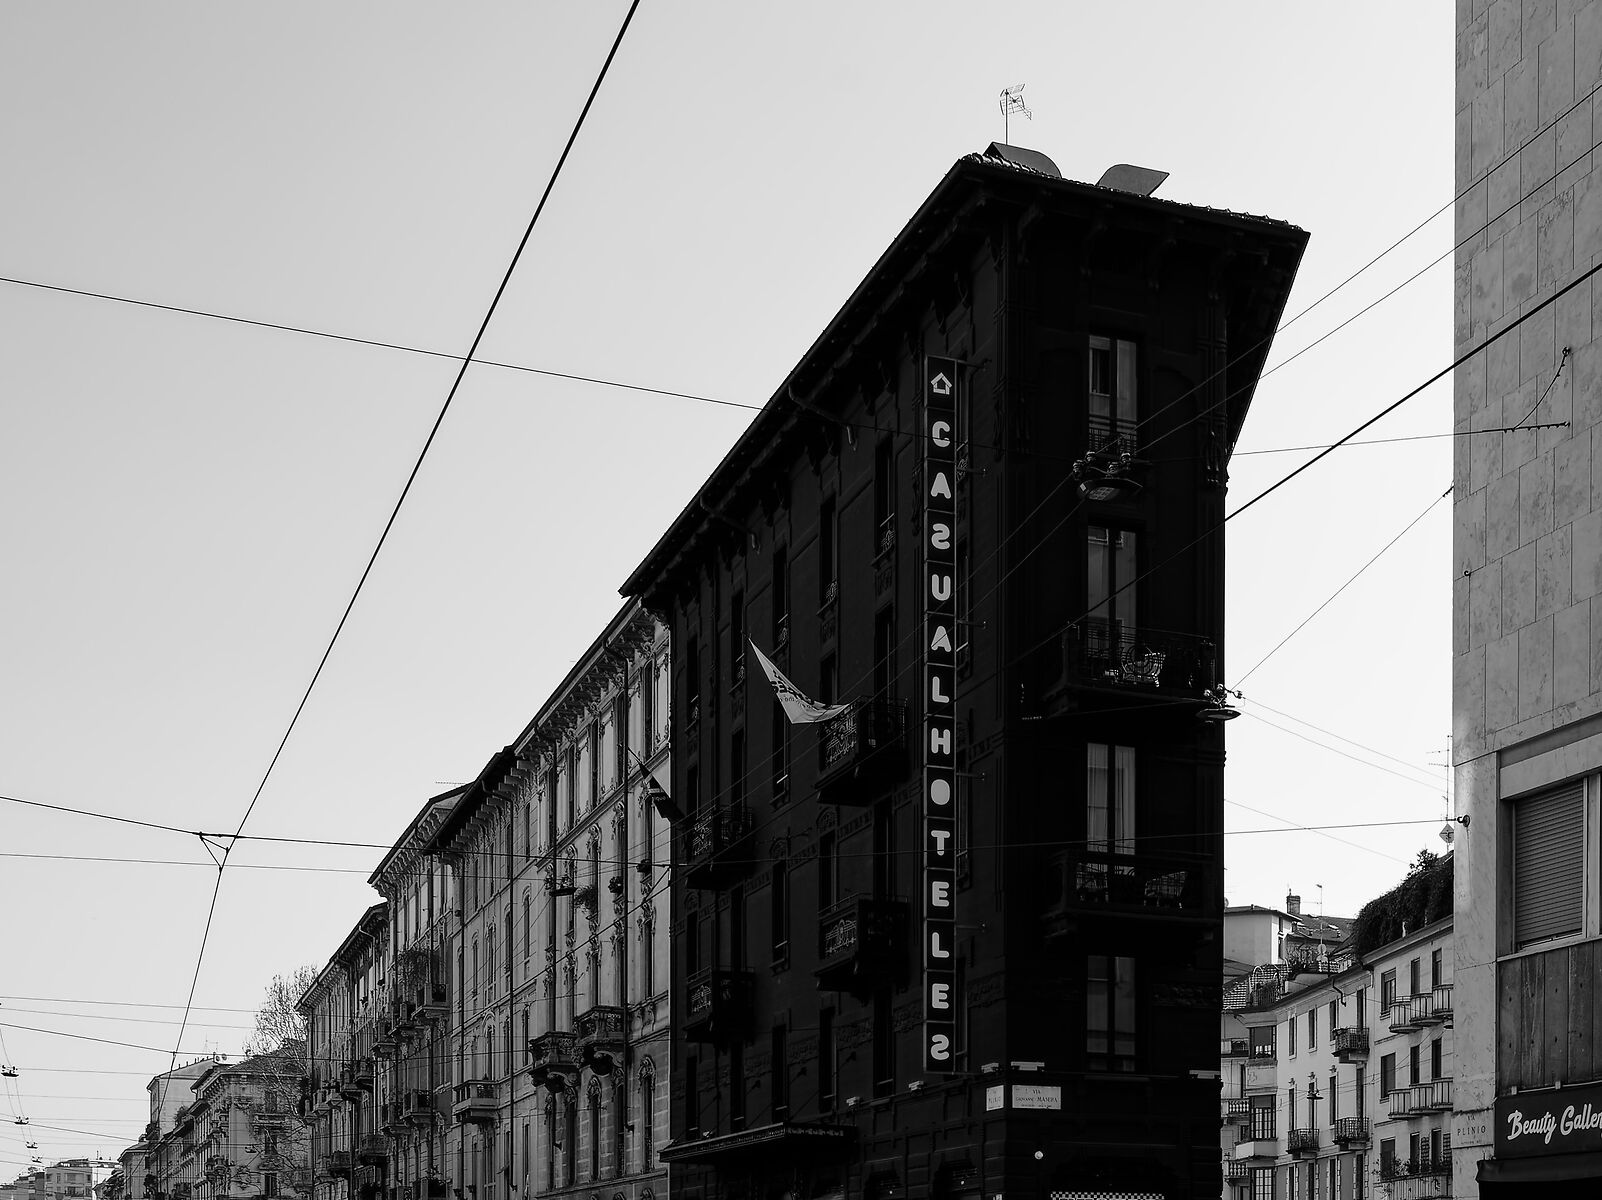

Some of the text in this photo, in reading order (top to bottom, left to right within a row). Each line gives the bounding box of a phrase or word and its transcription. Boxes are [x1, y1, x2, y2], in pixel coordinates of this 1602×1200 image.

[931, 727, 951, 1061] HOTELES
[1457, 1125, 1486, 1136] PLINIO
[1507, 1103, 1602, 1145] Beauty Galler
